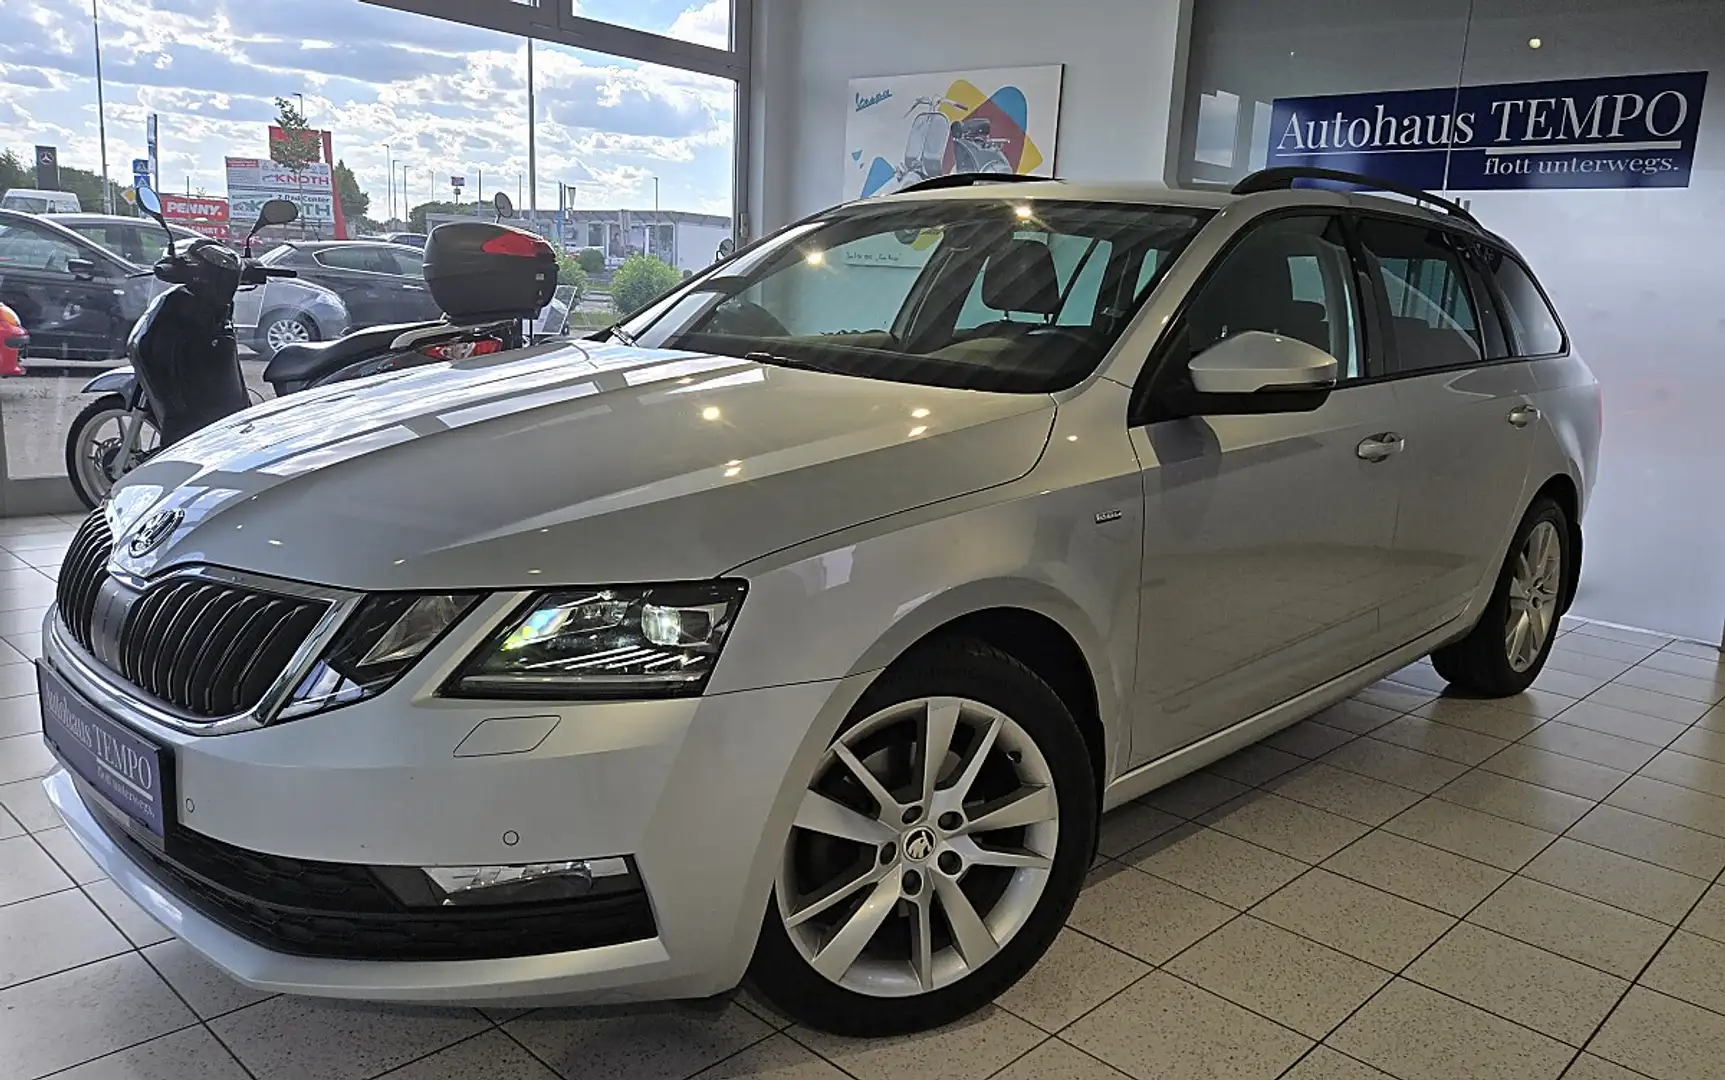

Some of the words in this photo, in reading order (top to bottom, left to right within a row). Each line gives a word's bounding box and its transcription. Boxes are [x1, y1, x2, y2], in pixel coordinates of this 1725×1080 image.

[1277, 104, 1475, 149] Autohaus
[1490, 90, 1688, 142] TEMPO
[275, 174, 329, 185] KNOTH
[1484, 157, 1532, 175] flott
[1537, 157, 1679, 175] unterwegs.
[45, 681, 92, 748] Autohaus
[92, 723, 152, 790] TEMPO
